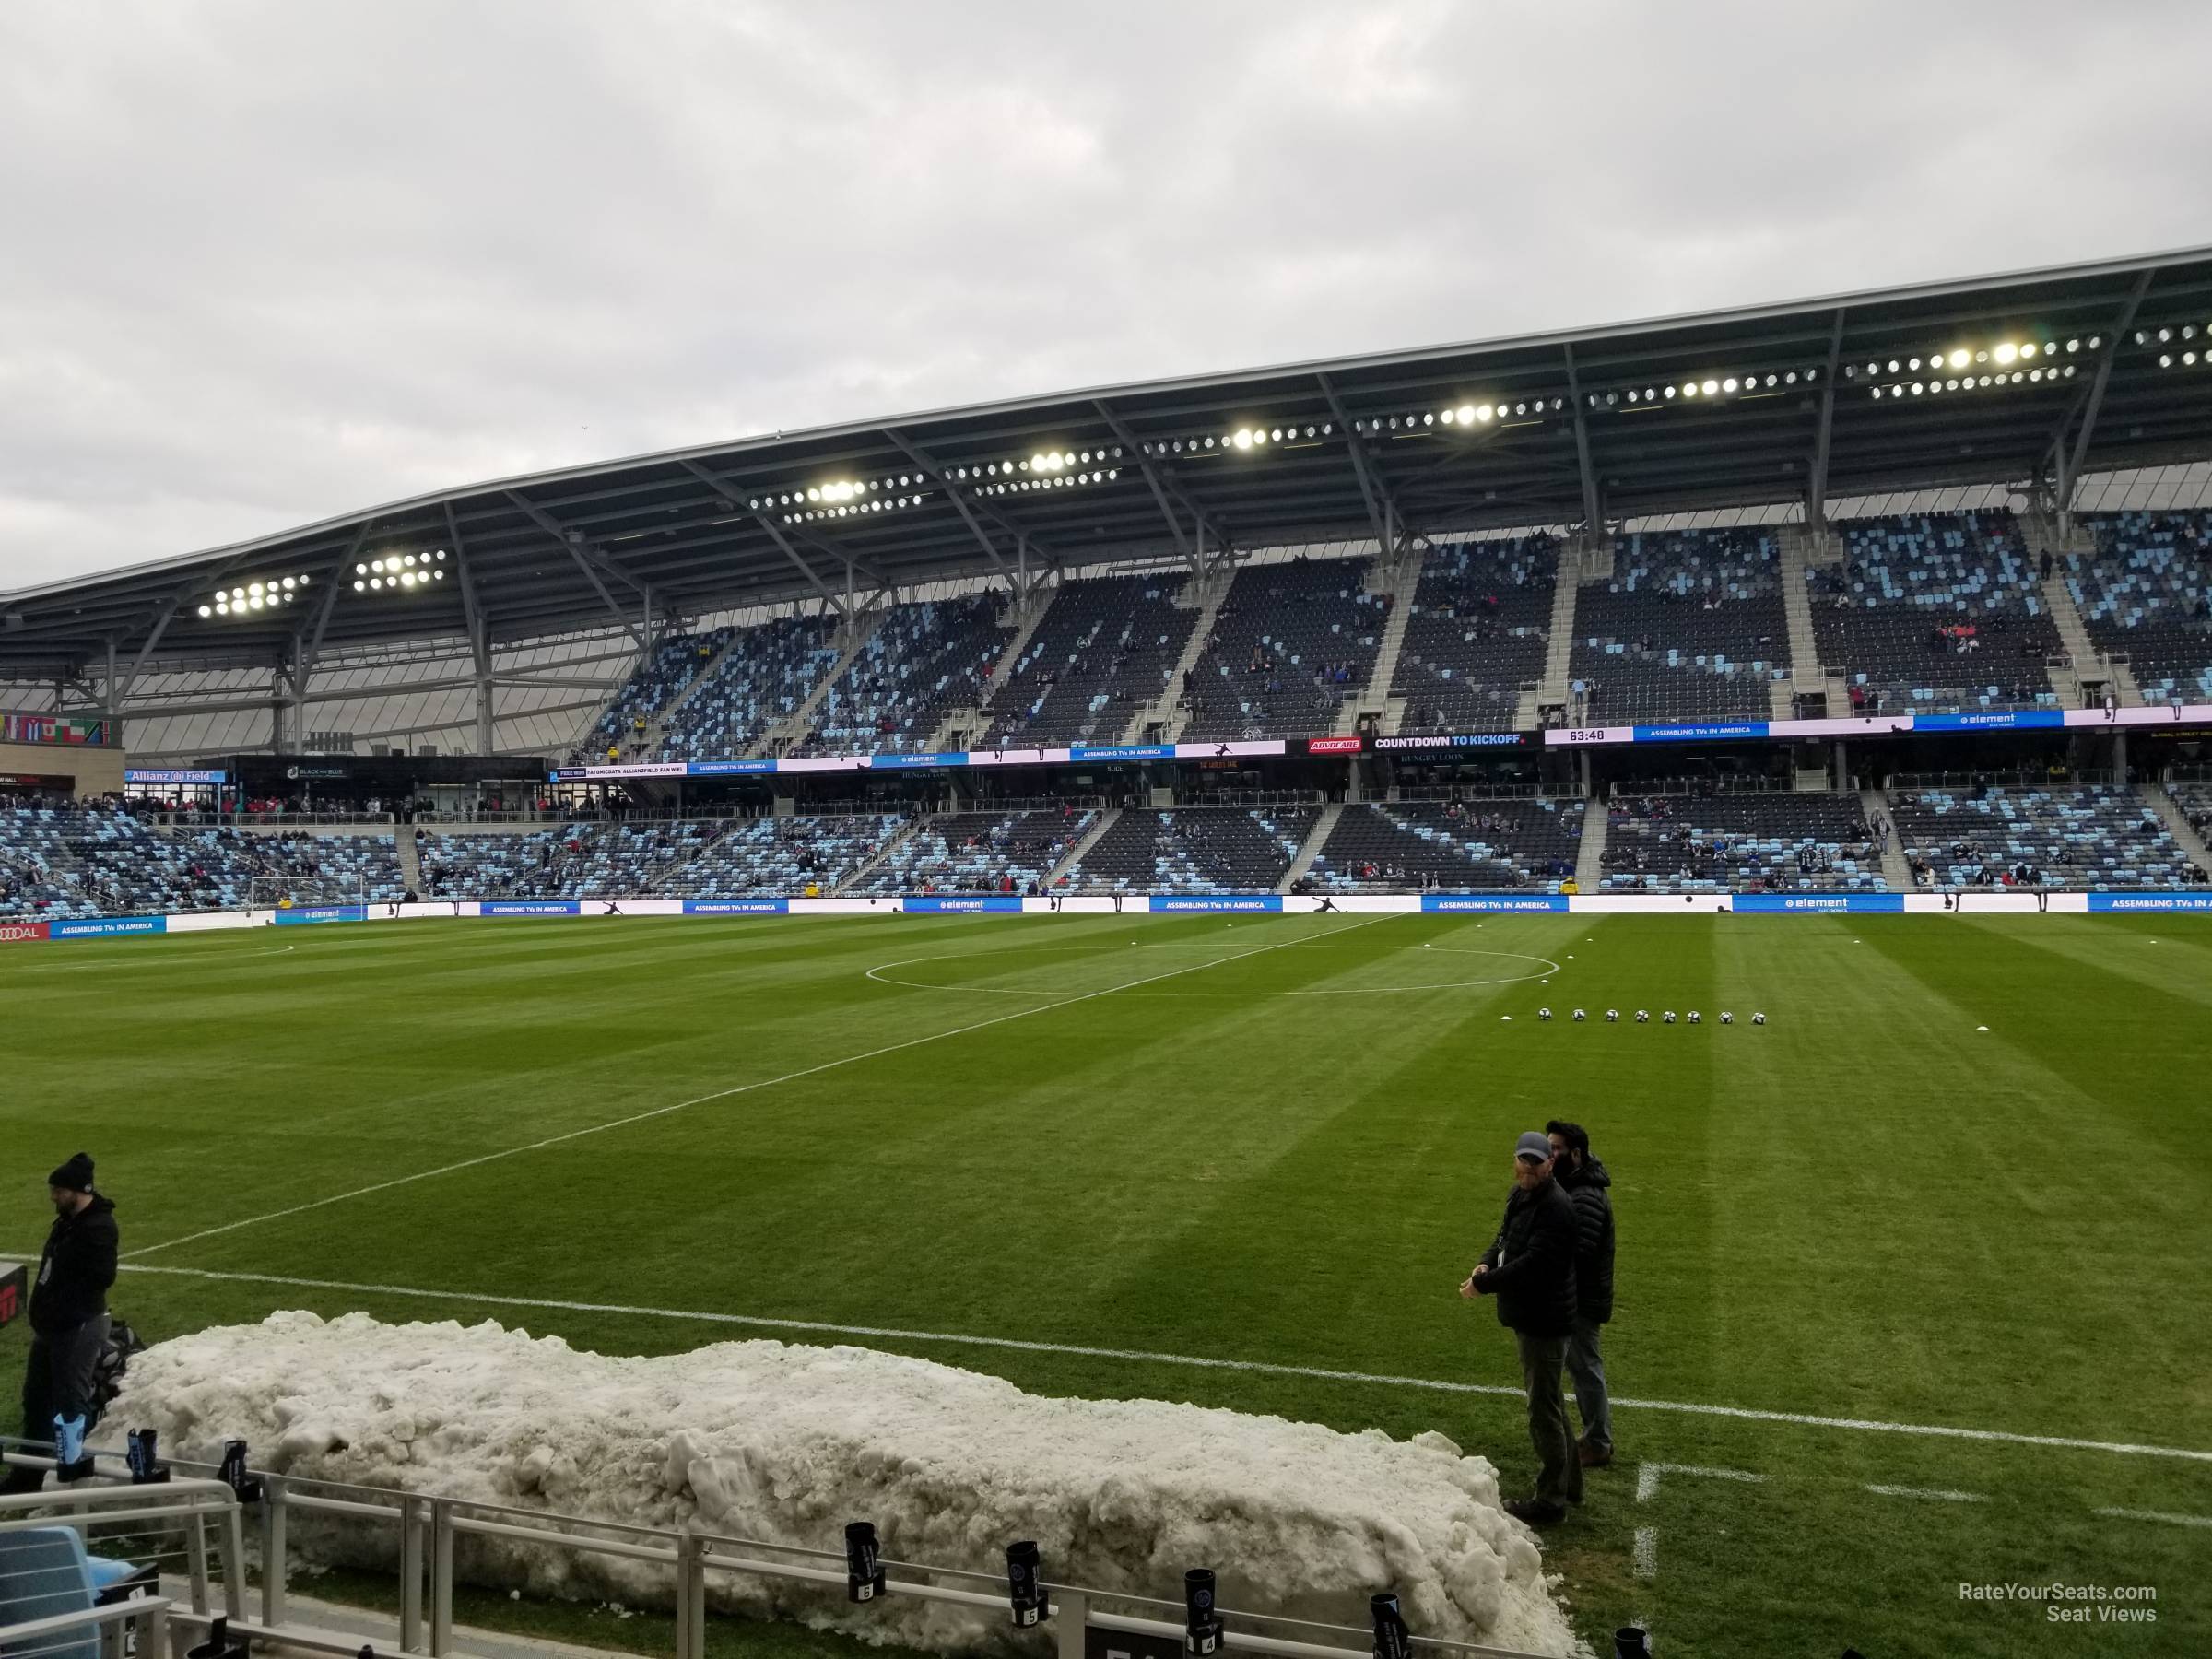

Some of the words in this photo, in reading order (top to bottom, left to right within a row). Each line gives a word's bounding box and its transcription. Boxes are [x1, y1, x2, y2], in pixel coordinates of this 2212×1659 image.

[1970, 713, 2015, 724] element
[1570, 730, 1604, 741] 63:48
[1651, 728, 1694, 736] ASSEMBLING
[1311, 740, 1360, 750] ADVOCARE
[1375, 736, 1450, 748] COUNTDOWN
[1452, 735, 1468, 746] TO
[907, 754, 937, 762] element
[1439, 753, 1465, 761] LOON
[132, 771, 169, 781] Allianz
[186, 771, 210, 781] Field
[947, 900, 983, 909] element
[1795, 898, 1848, 907] element
[2112, 900, 2173, 908] ASSEMBLING
[311, 909, 340, 918] element
[61, 925, 103, 934] ASSEMBLING
[125, 922, 153, 930] AMERICA
[864, 1586, 870, 1598] 6
[1029, 1610, 1035, 1622] 5
[1206, 1640, 1214, 1651] 4
